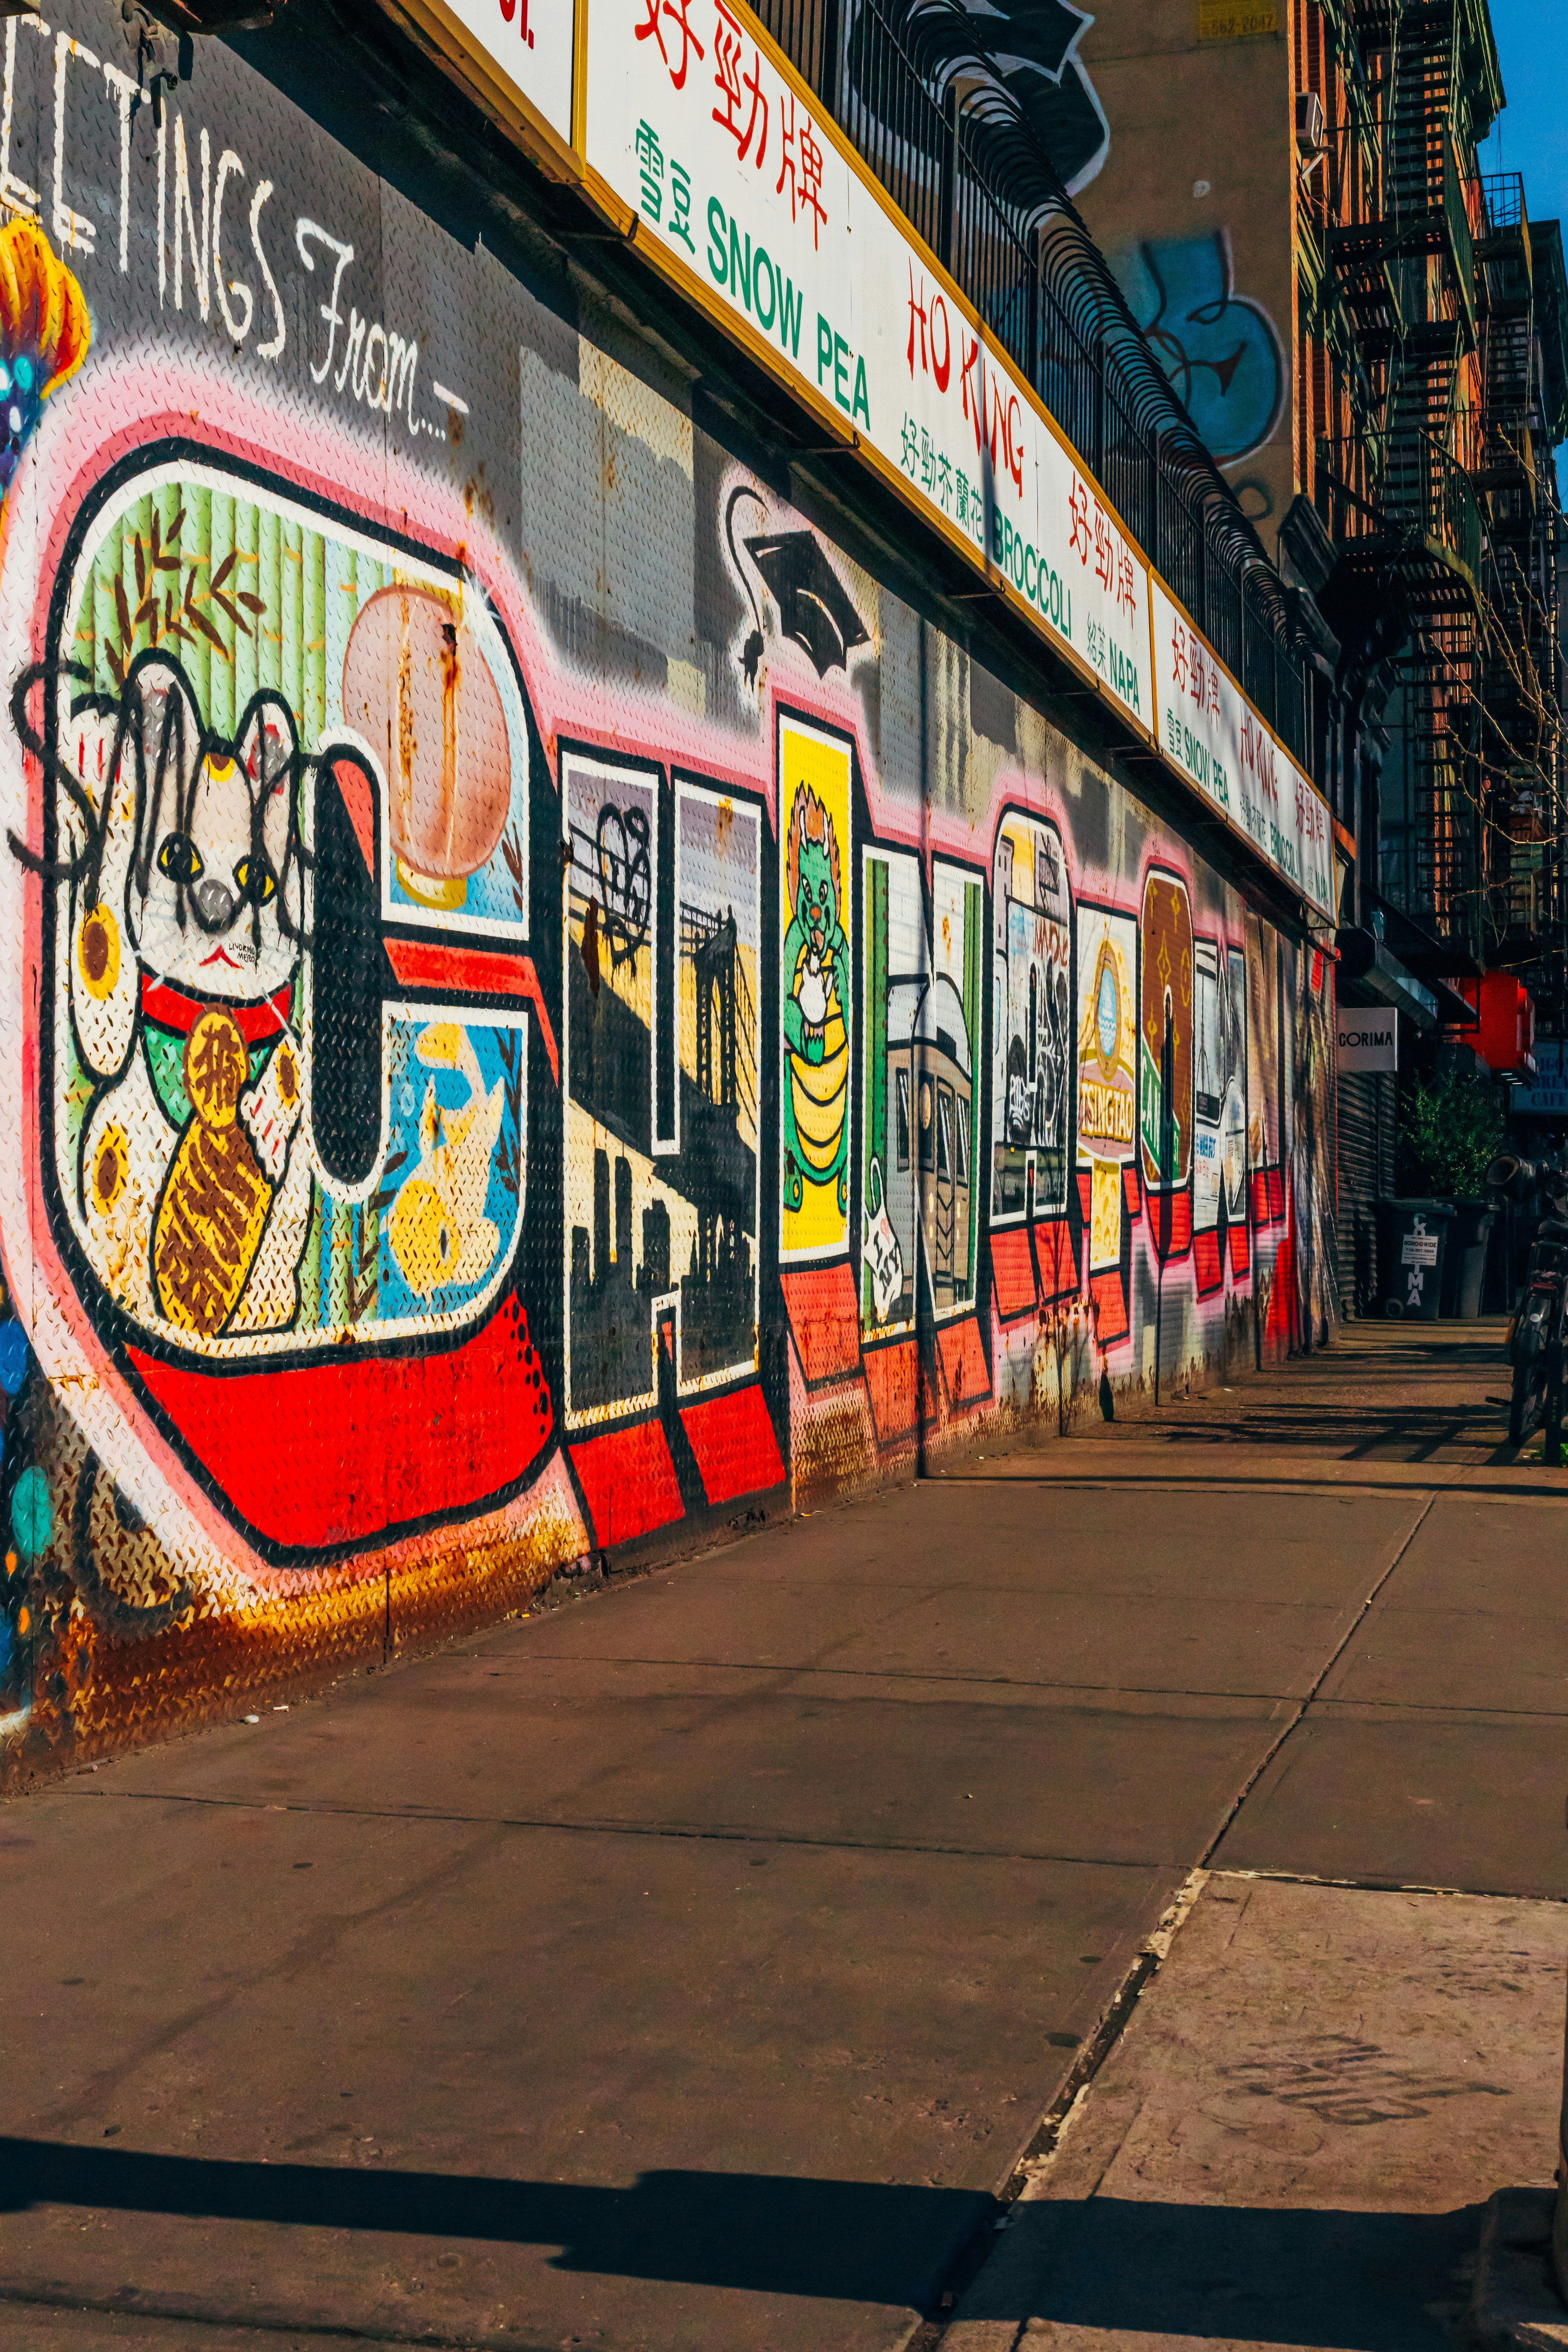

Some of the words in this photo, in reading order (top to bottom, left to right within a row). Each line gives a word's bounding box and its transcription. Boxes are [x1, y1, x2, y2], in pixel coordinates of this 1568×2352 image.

[636, 119, 695, 255] 雪豆
[707, 196, 803, 360] SNOW
[817, 312, 871, 432] PEA
[907, 256, 950, 394] HO
[960, 326, 1024, 501] KING
[901, 411, 983, 544] 好勁芥蘭花
[992, 501, 1072, 641] BROCCOLI
[1069, 471, 1136, 630] 好勁牌
[1110, 636, 1140, 716] NAPA
[1172, 616, 1220, 733] 好勁牌
[1185, 726, 1209, 789] SNOW
[1213, 757, 1230, 810] PEA
[1240, 703, 1254, 772] HO
[1256, 726, 1279, 809] KING
[1270, 821, 1299, 881] BROCCOLI
[237, 952, 255, 963] MERO
[1339, 1031, 1393, 1047] CORIMA
[1081, 1082, 1133, 1139] TSINGTAO
[874, 1230, 883, 1269] I
[879, 1241, 899, 1301] NY
[1407, 1213, 1427, 1306] COIMA
